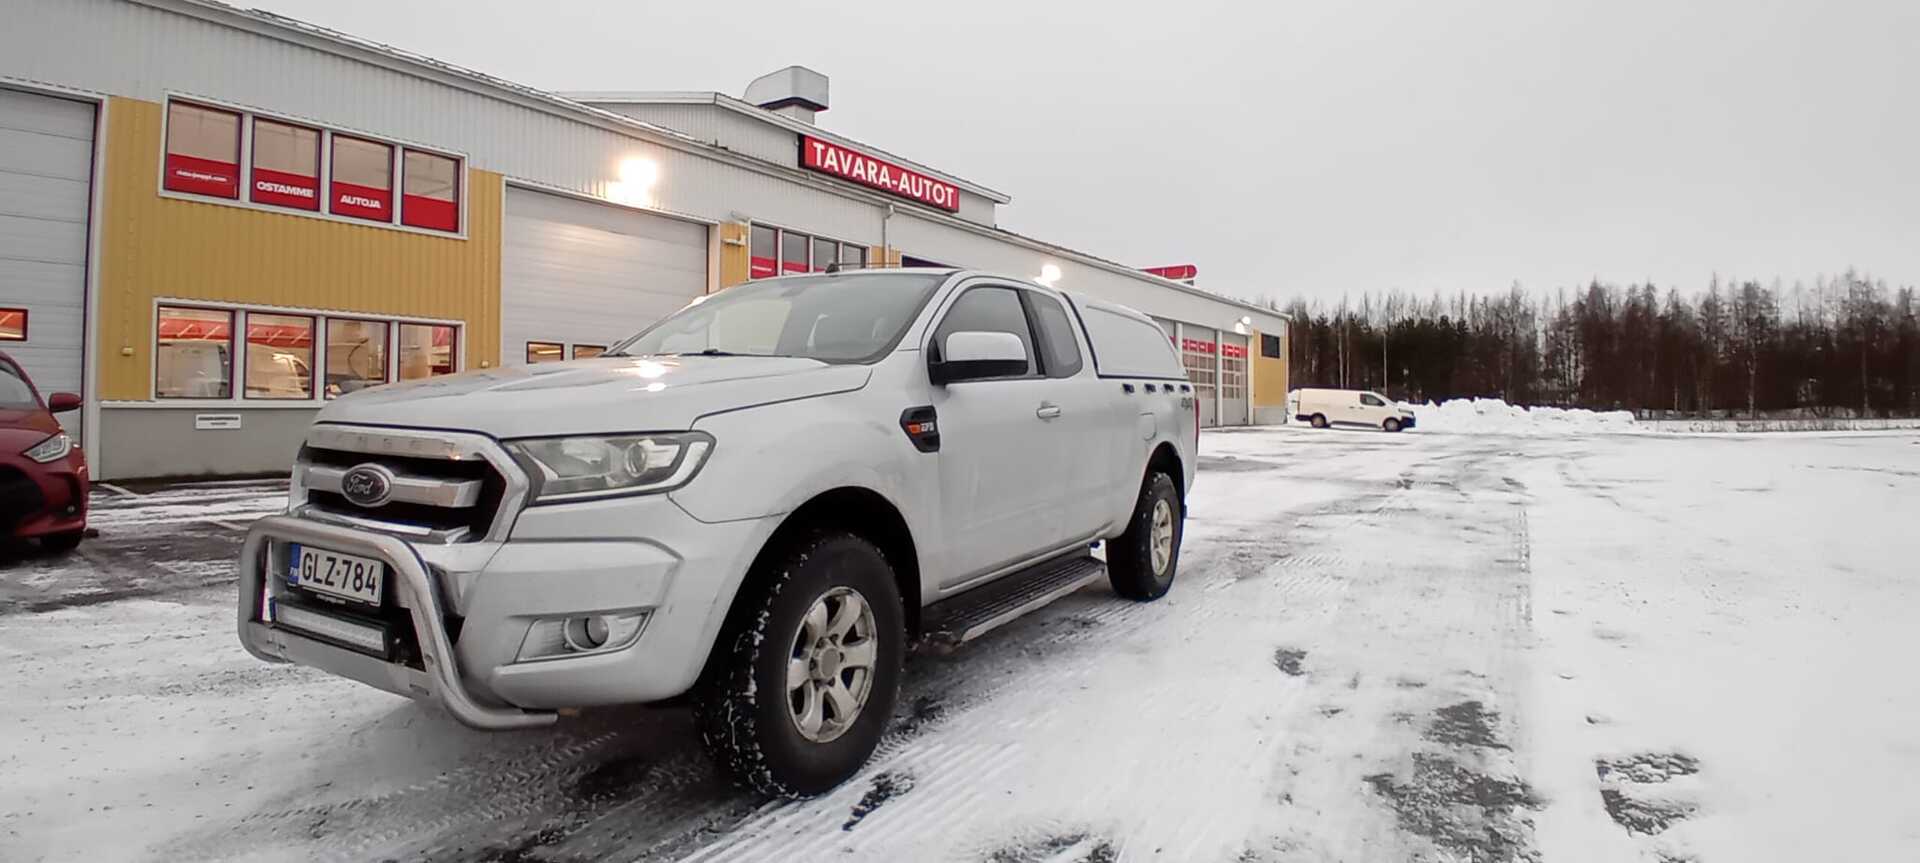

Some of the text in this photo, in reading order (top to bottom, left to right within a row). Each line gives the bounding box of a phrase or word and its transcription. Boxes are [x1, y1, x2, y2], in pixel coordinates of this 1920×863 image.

[812, 141, 955, 208] TAVARA-AUTOT
[256, 181, 382, 209] OSTAMME AUTOJA
[346, 472, 374, 496] Ford
[302, 551, 377, 597] GLZ-784
